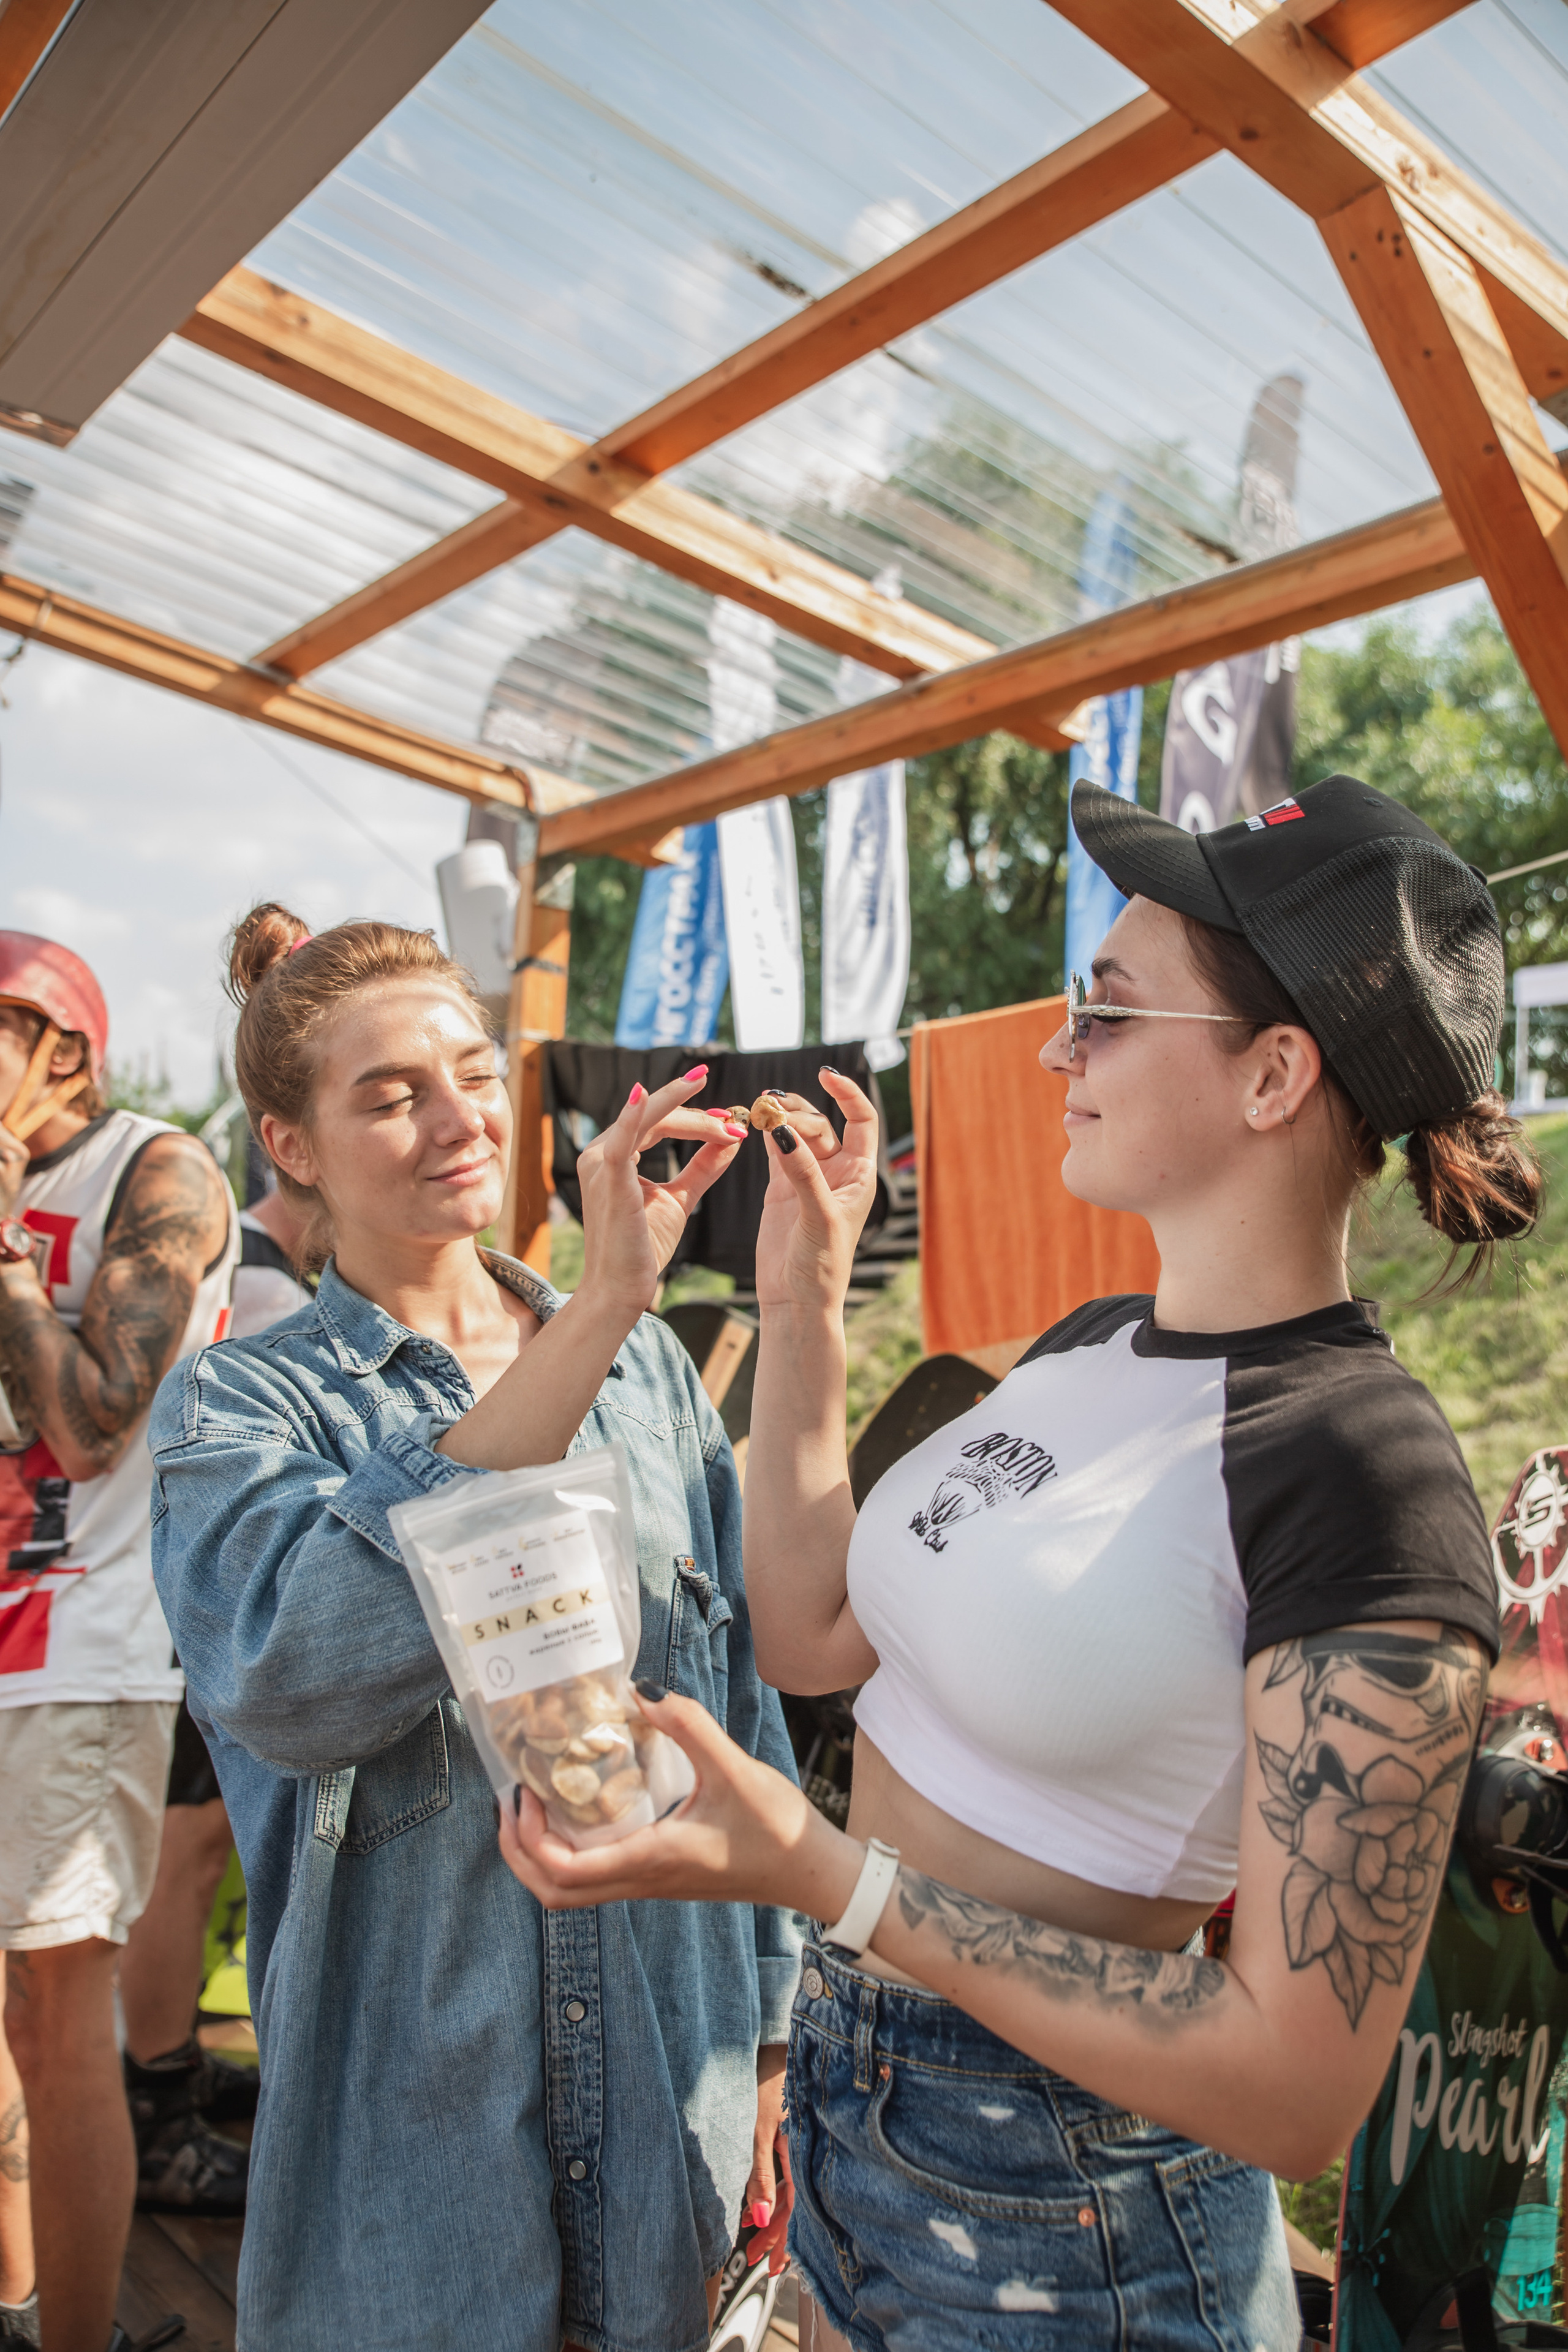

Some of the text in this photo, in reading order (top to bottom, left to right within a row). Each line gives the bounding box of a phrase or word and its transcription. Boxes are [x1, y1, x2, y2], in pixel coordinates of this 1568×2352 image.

[488, 1583, 522, 1600] SATTVA
[524, 1572, 557, 1588] FOODS
[475, 1589, 592, 1639] SNACK
[1448, 2010, 1528, 2068] Slingshot
